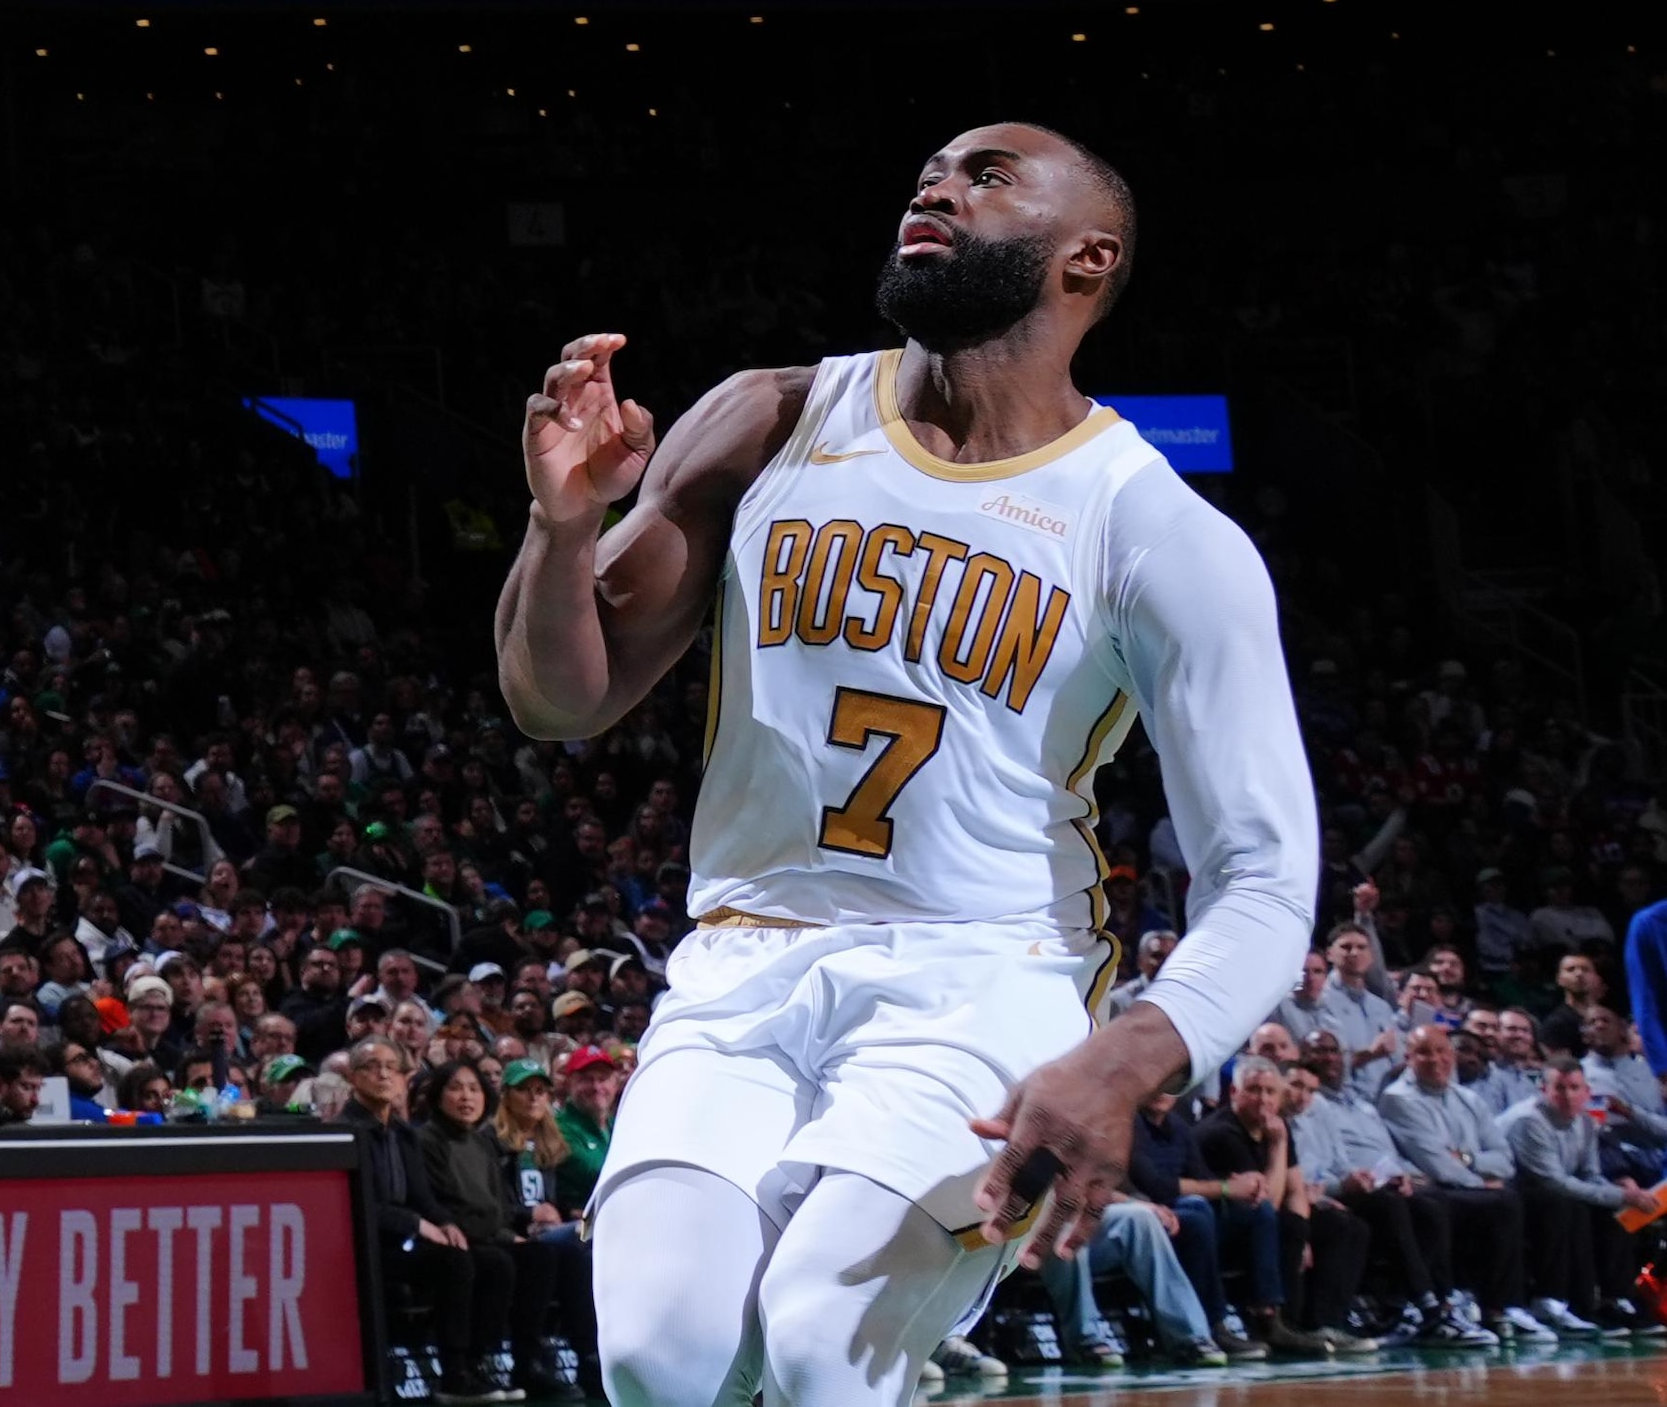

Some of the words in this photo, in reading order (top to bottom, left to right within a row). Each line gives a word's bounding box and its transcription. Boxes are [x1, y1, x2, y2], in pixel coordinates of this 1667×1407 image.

[982, 495, 1067, 536] Amica
[757, 519, 1071, 715] BOSTON
[817, 685, 947, 859] 7
[58, 1203, 309, 1384] BETTER
